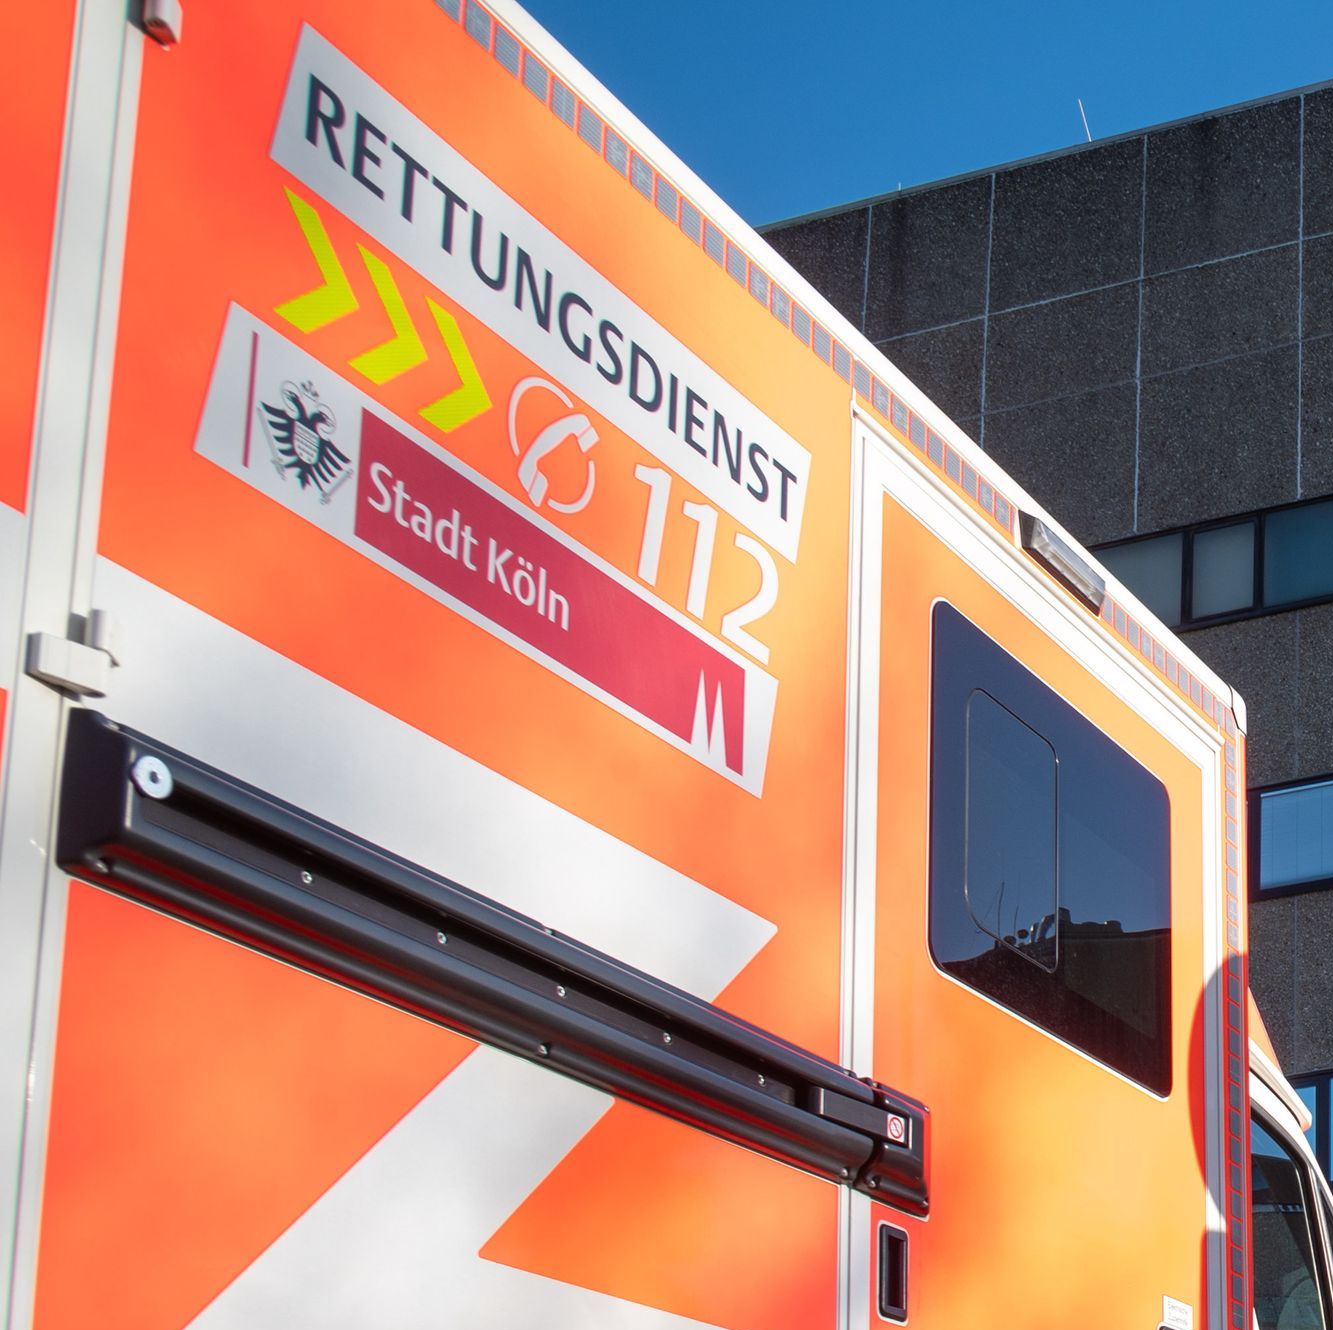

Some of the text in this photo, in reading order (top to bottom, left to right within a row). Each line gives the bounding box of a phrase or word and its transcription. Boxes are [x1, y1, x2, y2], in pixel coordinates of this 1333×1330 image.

[304, 73, 798, 523] RETTUNGSDIENST
[367, 461, 570, 632] Stadt Köln
[634, 463, 780, 666] 112
